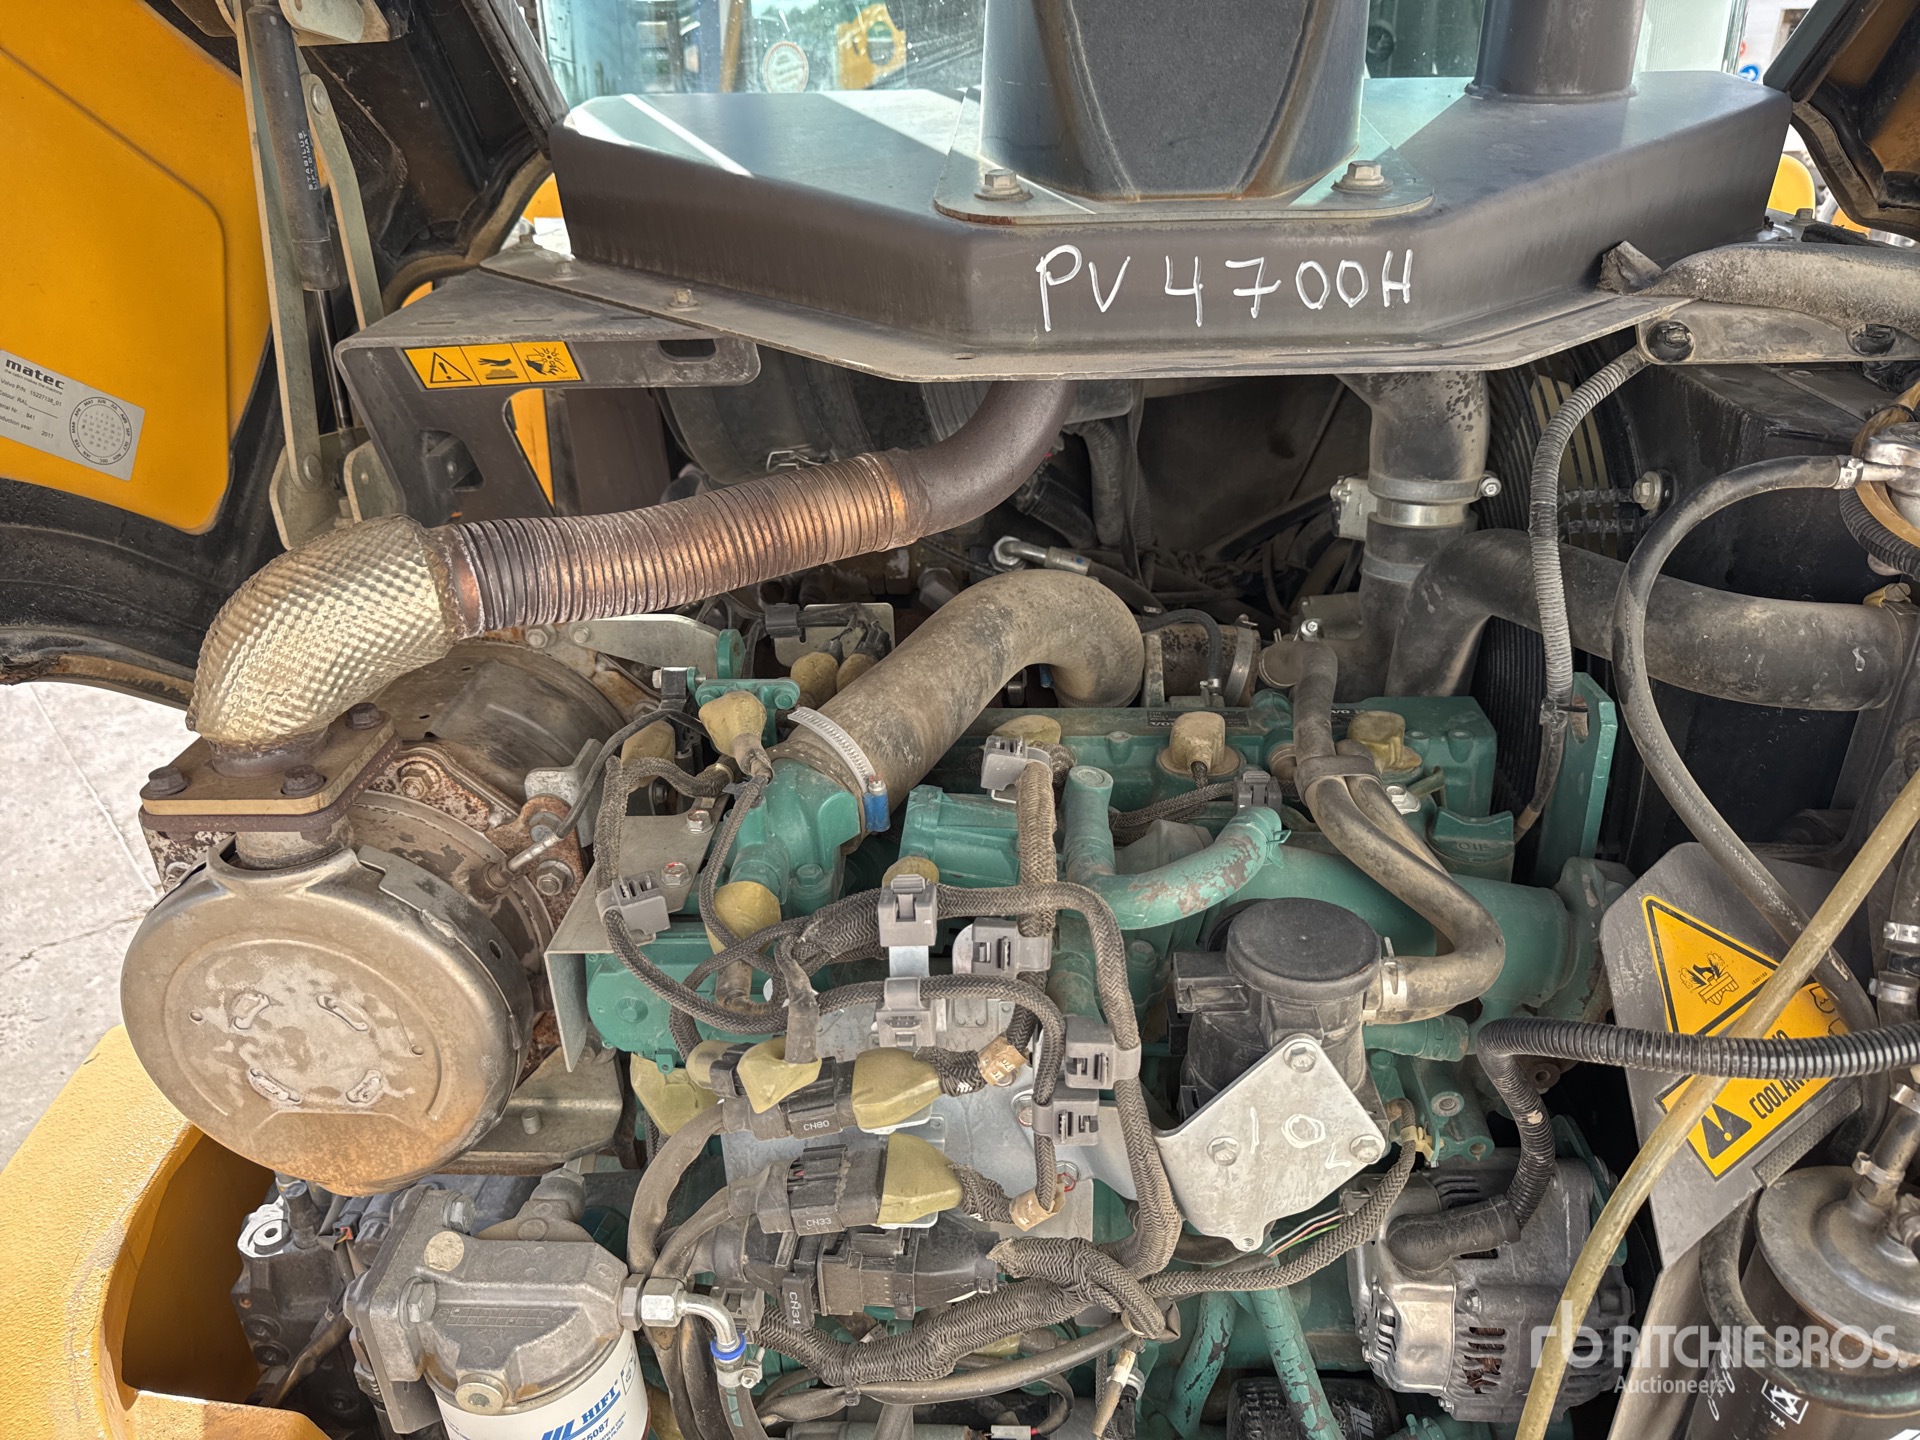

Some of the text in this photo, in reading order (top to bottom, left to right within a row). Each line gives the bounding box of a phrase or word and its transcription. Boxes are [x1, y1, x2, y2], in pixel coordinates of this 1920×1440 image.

[298, 132, 313, 190] STABILUS
[1036, 244, 1413, 332] PV 4700H
[1, 379, 15, 388] Volvo
[5, 359, 65, 390] matec
[0, 402, 10, 411] erial
[0, 415, 20, 427] oduction
[41, 430, 55, 439] 2017
[1749, 1079, 1811, 1119] COOLAN
[803, 1120, 830, 1131] CN80
[806, 1218, 832, 1227] CN33
[790, 1292, 801, 1324] CN31
[581, 1386, 616, 1424] HIFI
[580, 1417, 609, 1440] 5087
